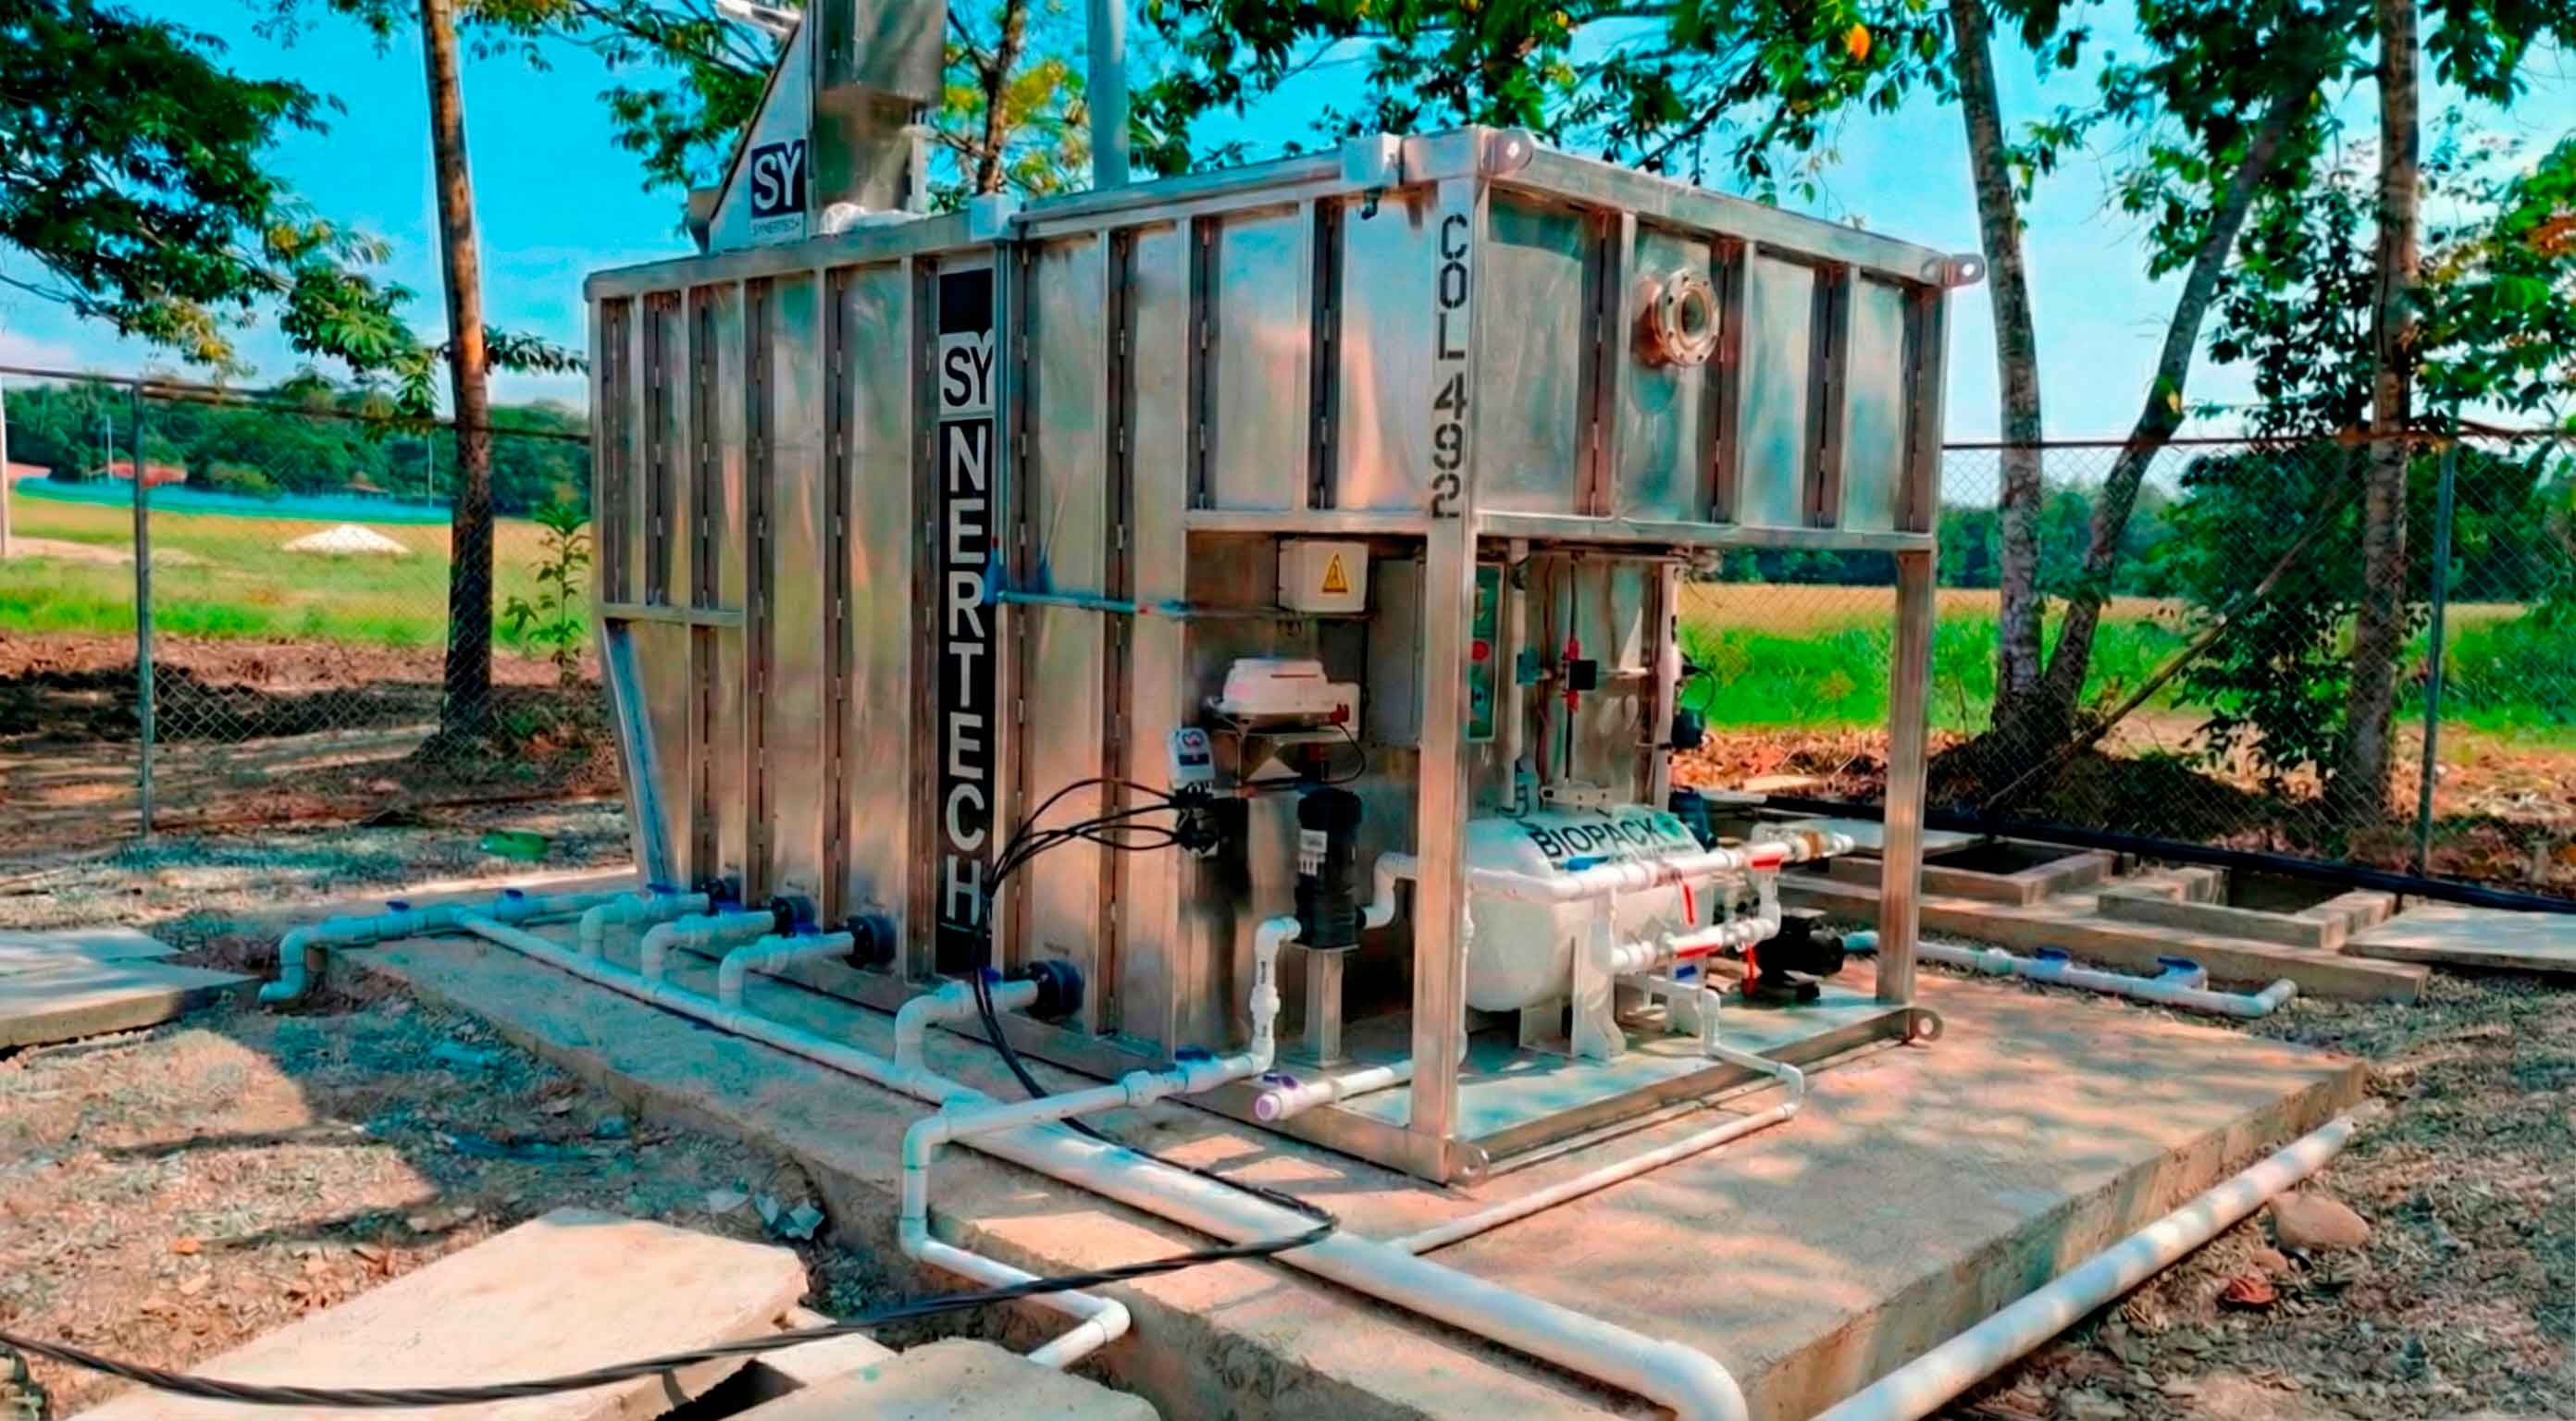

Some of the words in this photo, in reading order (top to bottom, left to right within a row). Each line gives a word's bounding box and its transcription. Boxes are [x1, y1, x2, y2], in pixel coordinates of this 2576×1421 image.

[754, 146, 802, 210] SY
[1439, 214, 1468, 361] COL
[1431, 372, 1468, 519] 492
[1531, 818, 1666, 858] BIOPACK
